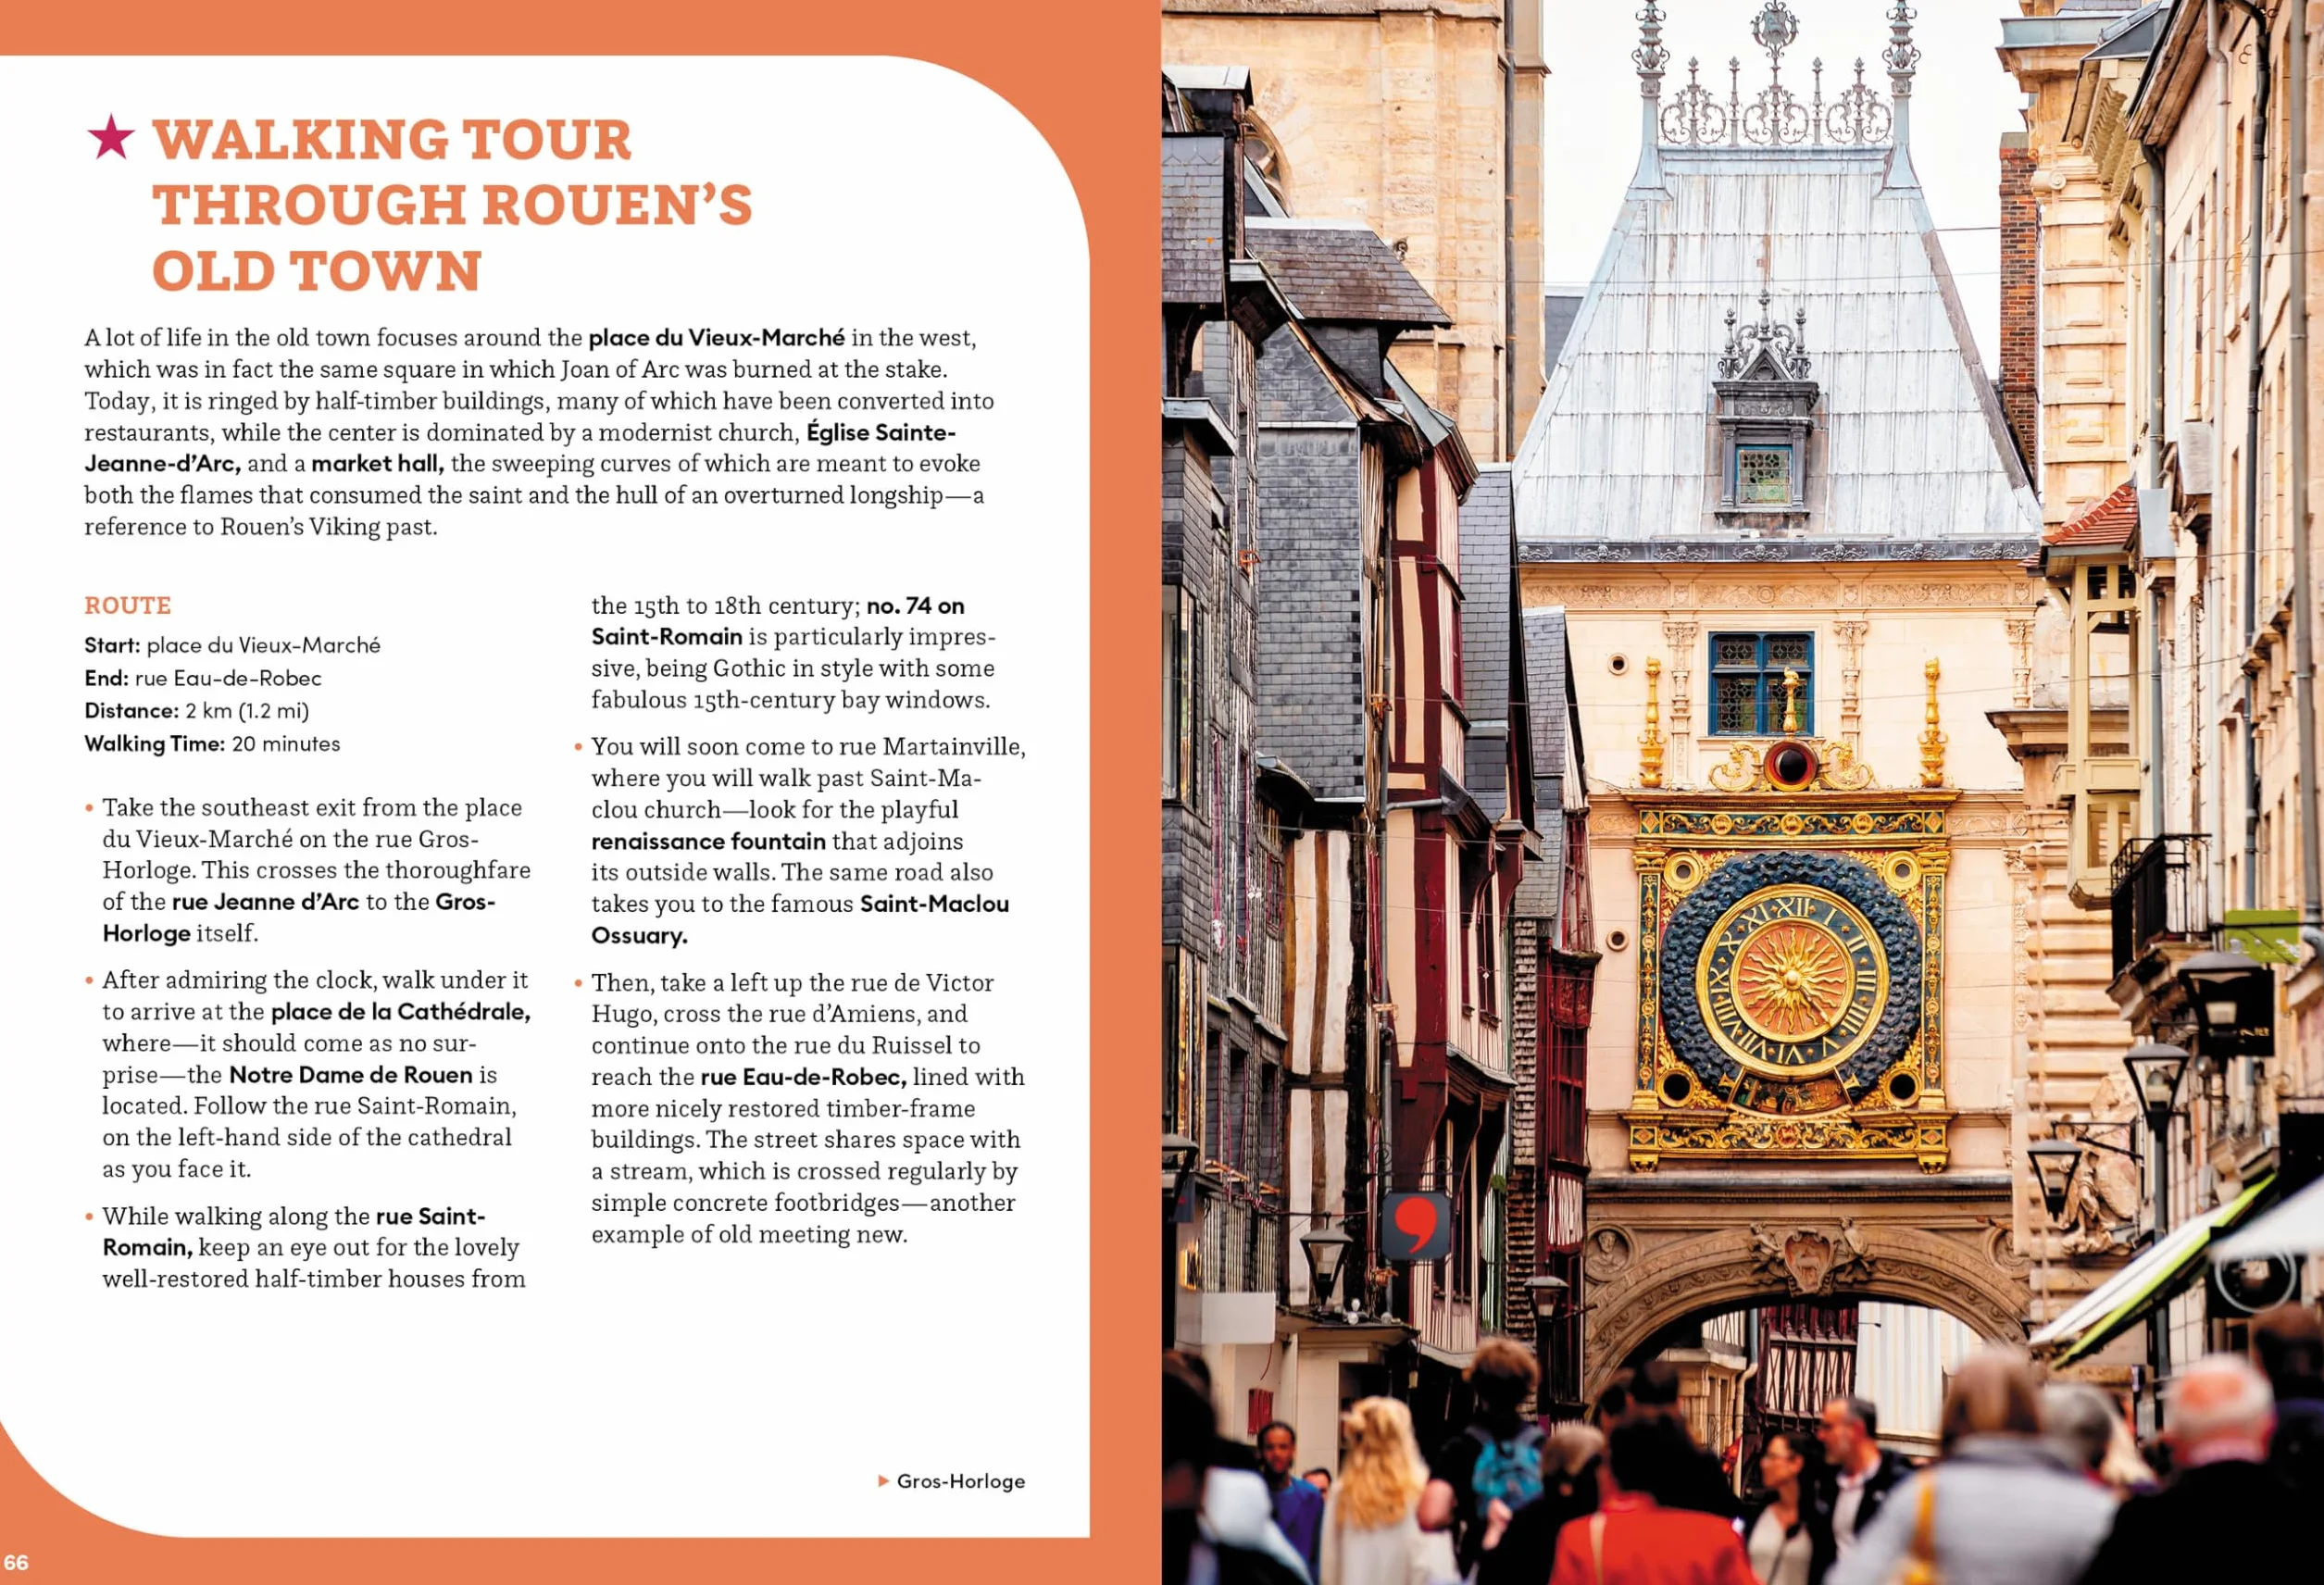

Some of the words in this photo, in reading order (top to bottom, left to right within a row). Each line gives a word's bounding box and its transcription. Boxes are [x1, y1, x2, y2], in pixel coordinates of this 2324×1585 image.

[151, 118, 449, 161] WALKING
[462, 118, 632, 161] TOUR
[152, 183, 467, 226] THROUGH
[152, 249, 275, 293] OLD
[289, 249, 482, 293] TOWN
[83, 328, 102, 347] A
[106, 327, 135, 347] lot
[140, 326, 164, 347] of
[167, 326, 203, 347] life
[206, 328, 230, 347] in
[234, 327, 270, 347] the
[276, 327, 310, 347] old
[315, 330, 371, 347] town
[377, 326, 458, 347] focuses
[464, 327, 542, 347] around
[547, 327, 582, 347] the
[589, 327, 651, 352] place
[655, 327, 683, 347] du
[687, 327, 846, 347] Vieux-Marché
[851, 328, 874, 347] in
[878, 327, 914, 347] the
[918, 330, 977, 351] west,
[84, 424, 216, 446] restaurants,
[220, 421, 281, 442] while
[286, 421, 322, 442] the
[328, 424, 397, 442] center
[401, 422, 420, 442] is
[427, 421, 545, 442] dominated
[548, 421, 577, 448] by
[581, 428, 593, 442] a
[598, 421, 713, 442] modernist
[718, 421, 800, 446] church,
[806, 418, 870, 447] Église
[875, 421, 956, 442] Sainte-
[83, 516, 187, 536] reference
[193, 518, 215, 536] to
[308, 516, 381, 542] Viking
[385, 518, 438, 542] past.
[84, 595, 171, 615] ROUTE
[591, 594, 628, 615] the
[634, 594, 681, 619] 15th
[686, 598, 708, 615] to
[715, 594, 762, 615] 18th
[768, 598, 860, 620] century;
[867, 601, 901, 615] no.
[906, 595, 933, 615] 74
[937, 601, 965, 615] on
[84, 636, 141, 654] Start:
[147, 635, 203, 659] place
[207, 635, 233, 654] du
[238, 635, 381, 655] Vieux-Marché
[592, 626, 743, 646] Saint-Romain
[748, 627, 768, 646] is
[773, 626, 905, 652] particularly
[908, 627, 996, 652] impres-
[85, 668, 129, 687] End:
[135, 674, 168, 687] rue
[174, 668, 322, 687] Eau-de-Robec
[85, 701, 180, 719] Distance:
[185, 702, 196, 719] 2
[203, 700, 232, 719] km
[238, 702, 271, 724] (1.2
[277, 702, 309, 724] mi)
[591, 688, 687, 709] fabulous
[693, 689, 837, 715] 15th-century
[840, 689, 881, 715] bay
[884, 689, 991, 709] windows.
[83, 733, 166, 758] Walking
[169, 734, 225, 753] Time:
[231, 735, 256, 753] 20
[263, 734, 341, 753] minutes
[591, 736, 634, 756] You
[639, 735, 681, 756] will
[687, 742, 740, 756] soon
[745, 742, 806, 756] come
[810, 739, 833, 755] to
[839, 742, 877, 756] rue
[882, 735, 1026, 760] Martainville,
[102, 796, 154, 817] Take
[159, 796, 195, 817] the
[201, 796, 310, 817] southeast
[316, 798, 356, 817] exit
[362, 796, 418, 817] from
[422, 796, 458, 817] the
[465, 796, 522, 823] place
[102, 859, 197, 885] Horloge.
[201, 859, 250, 880] This
[256, 865, 337, 880] crosses
[343, 859, 380, 880] the
[384, 858, 531, 885] thoroughfare
[591, 972, 656, 996] Then,
[660, 972, 706, 992] take
[713, 978, 725, 992] a
[731, 971, 768, 992] left
[773, 978, 803, 998] up
[808, 972, 845, 992] the
[851, 978, 888, 992] rue
[894, 972, 920, 992] de
[925, 973, 995, 992] Victor
[102, 1004, 125, 1021] to
[131, 1002, 196, 1021] arrive
[201, 1004, 224, 1021] at
[228, 1001, 265, 1021] the
[271, 1001, 333, 1026] place
[337, 1001, 367, 1021] de
[372, 1001, 392, 1021] la
[397, 1001, 531, 1024] Cathédrale,
[230, 1065, 294, 1084] Notre
[299, 1065, 365, 1084] Dame
[369, 1064, 399, 1084] de
[404, 1065, 473, 1084] Rouen
[479, 1065, 497, 1084] is
[591, 1066, 653, 1086] reach
[658, 1066, 695, 1086] the
[701, 1072, 738, 1086] rue
[743, 1066, 907, 1090] Eau-de-Robec,
[913, 1066, 969, 1086] lined
[974, 1066, 1026, 1086] with
[102, 1164, 126, 1179] as
[131, 1164, 172, 1184] you
[177, 1157, 224, 1179] face
[229, 1159, 252, 1179] it.
[591, 1192, 667, 1217] simple
[673, 1194, 768, 1212] concrete
[103, 1237, 194, 1260] Romain,
[198, 1236, 251, 1262] keep
[257, 1242, 284, 1256] an
[290, 1242, 327, 1262] eye
[332, 1239, 370, 1256] out
[376, 1236, 408, 1256] for
[413, 1236, 449, 1256] the
[454, 1236, 520, 1262] lovely
[897, 1472, 1026, 1493] Gros-Horloge
[4, 1554, 30, 1571] 66
